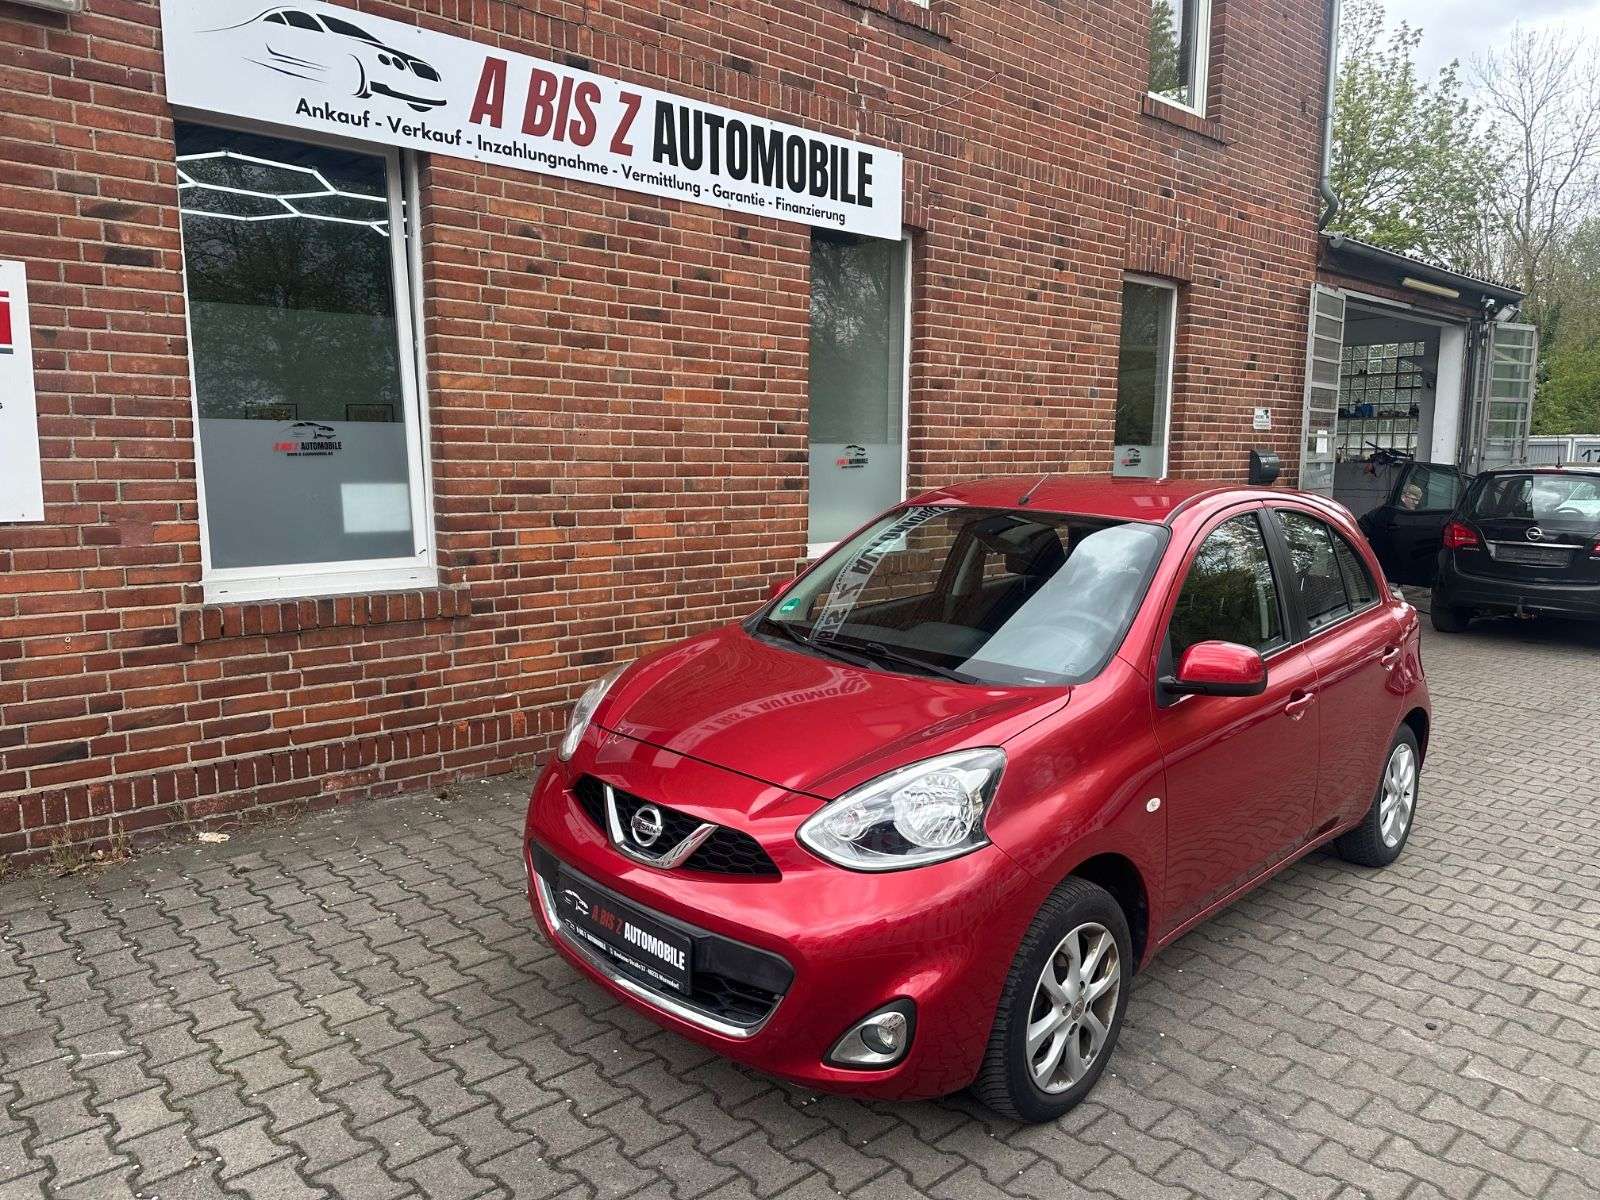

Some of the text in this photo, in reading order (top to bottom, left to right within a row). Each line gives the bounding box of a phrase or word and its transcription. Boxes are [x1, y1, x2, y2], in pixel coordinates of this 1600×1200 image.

[295, 97, 370, 128] Ankauf
[386, 115, 462, 146] Verkauf
[477, 134, 609, 175] Inzahlungnahme
[620, 164, 701, 197] Vermittlung
[712, 184, 765, 206] Garantie
[775, 196, 846, 225] Finanzierung
[469, 56, 873, 208] A BIS Z AUTOMOBILE
[301, 441, 342, 450] AUTOMOBILE
[591, 904, 599, 921] A
[600, 909, 615, 930] BIS
[616, 918, 623, 935] Z
[624, 921, 685, 970] AUTOMOBILE
